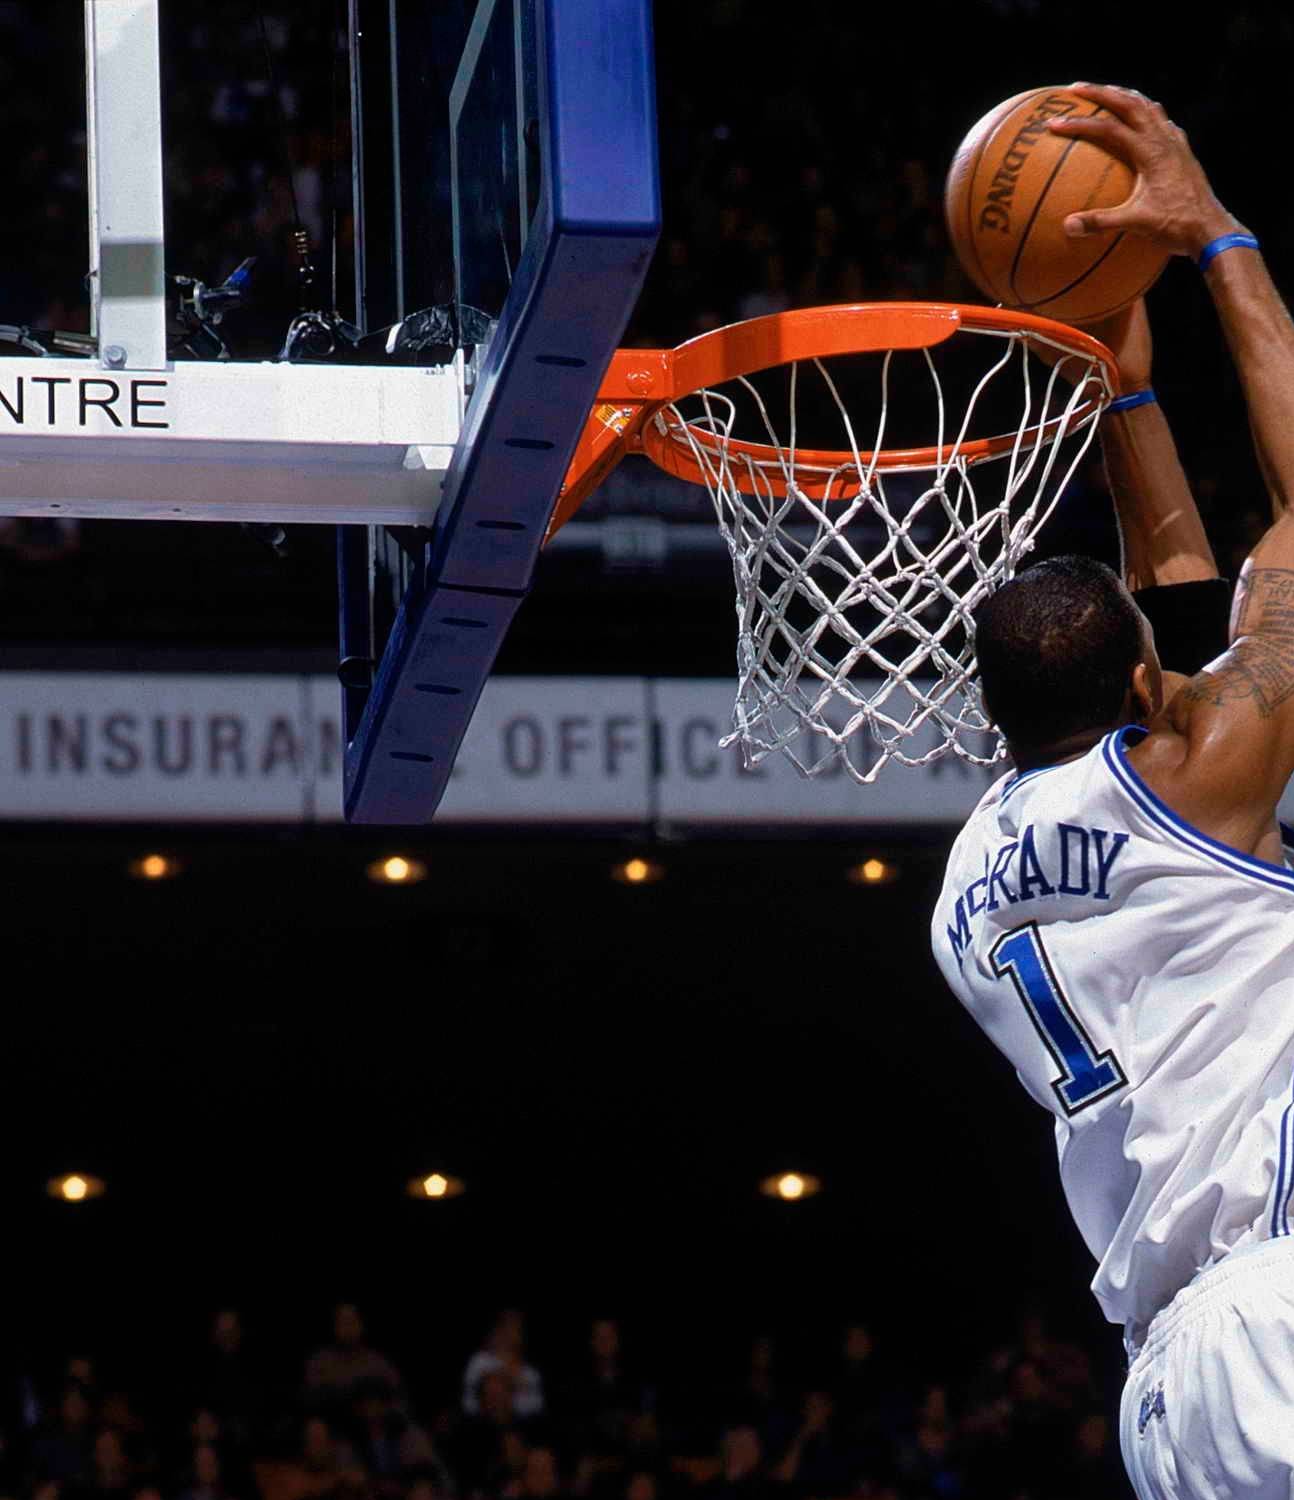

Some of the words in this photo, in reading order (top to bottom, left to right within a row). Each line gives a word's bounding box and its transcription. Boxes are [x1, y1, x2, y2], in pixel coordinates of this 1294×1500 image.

[14, 712, 465, 777] INSURAN
[502, 714, 768, 781] OFFICE
[988, 919, 1128, 1117] 1
